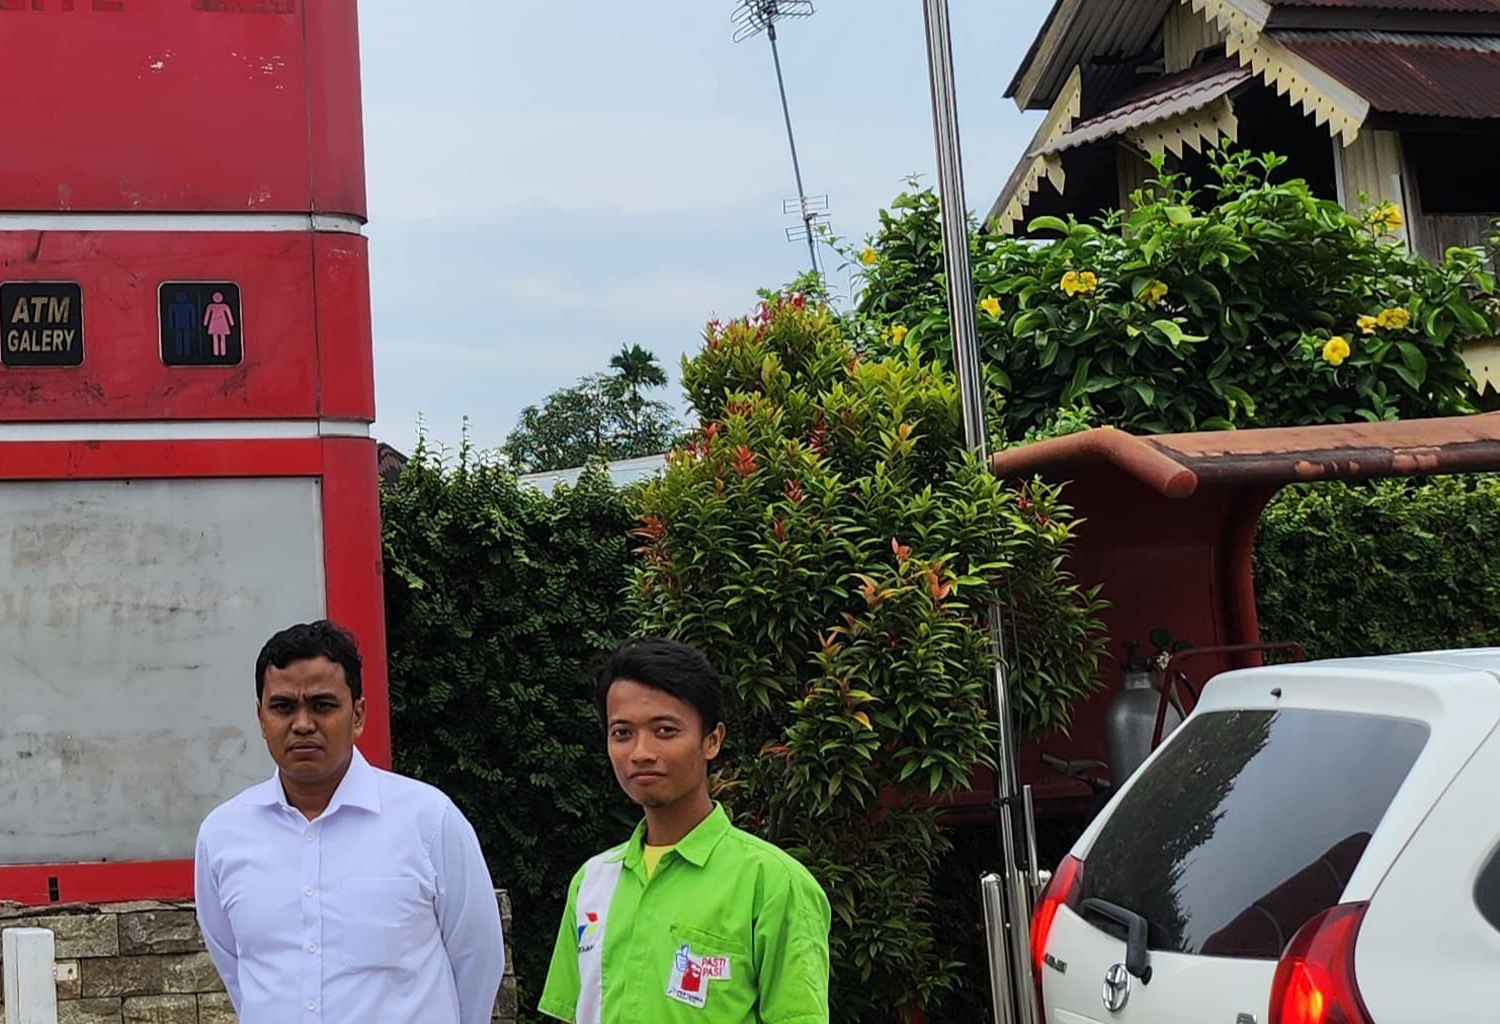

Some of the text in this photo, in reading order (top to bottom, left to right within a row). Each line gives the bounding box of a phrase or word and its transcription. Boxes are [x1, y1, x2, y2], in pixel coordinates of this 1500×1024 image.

[12, 296, 70, 323] ATM
[7, 329, 76, 352] GALERY
[702, 957, 726, 967] PASTI
